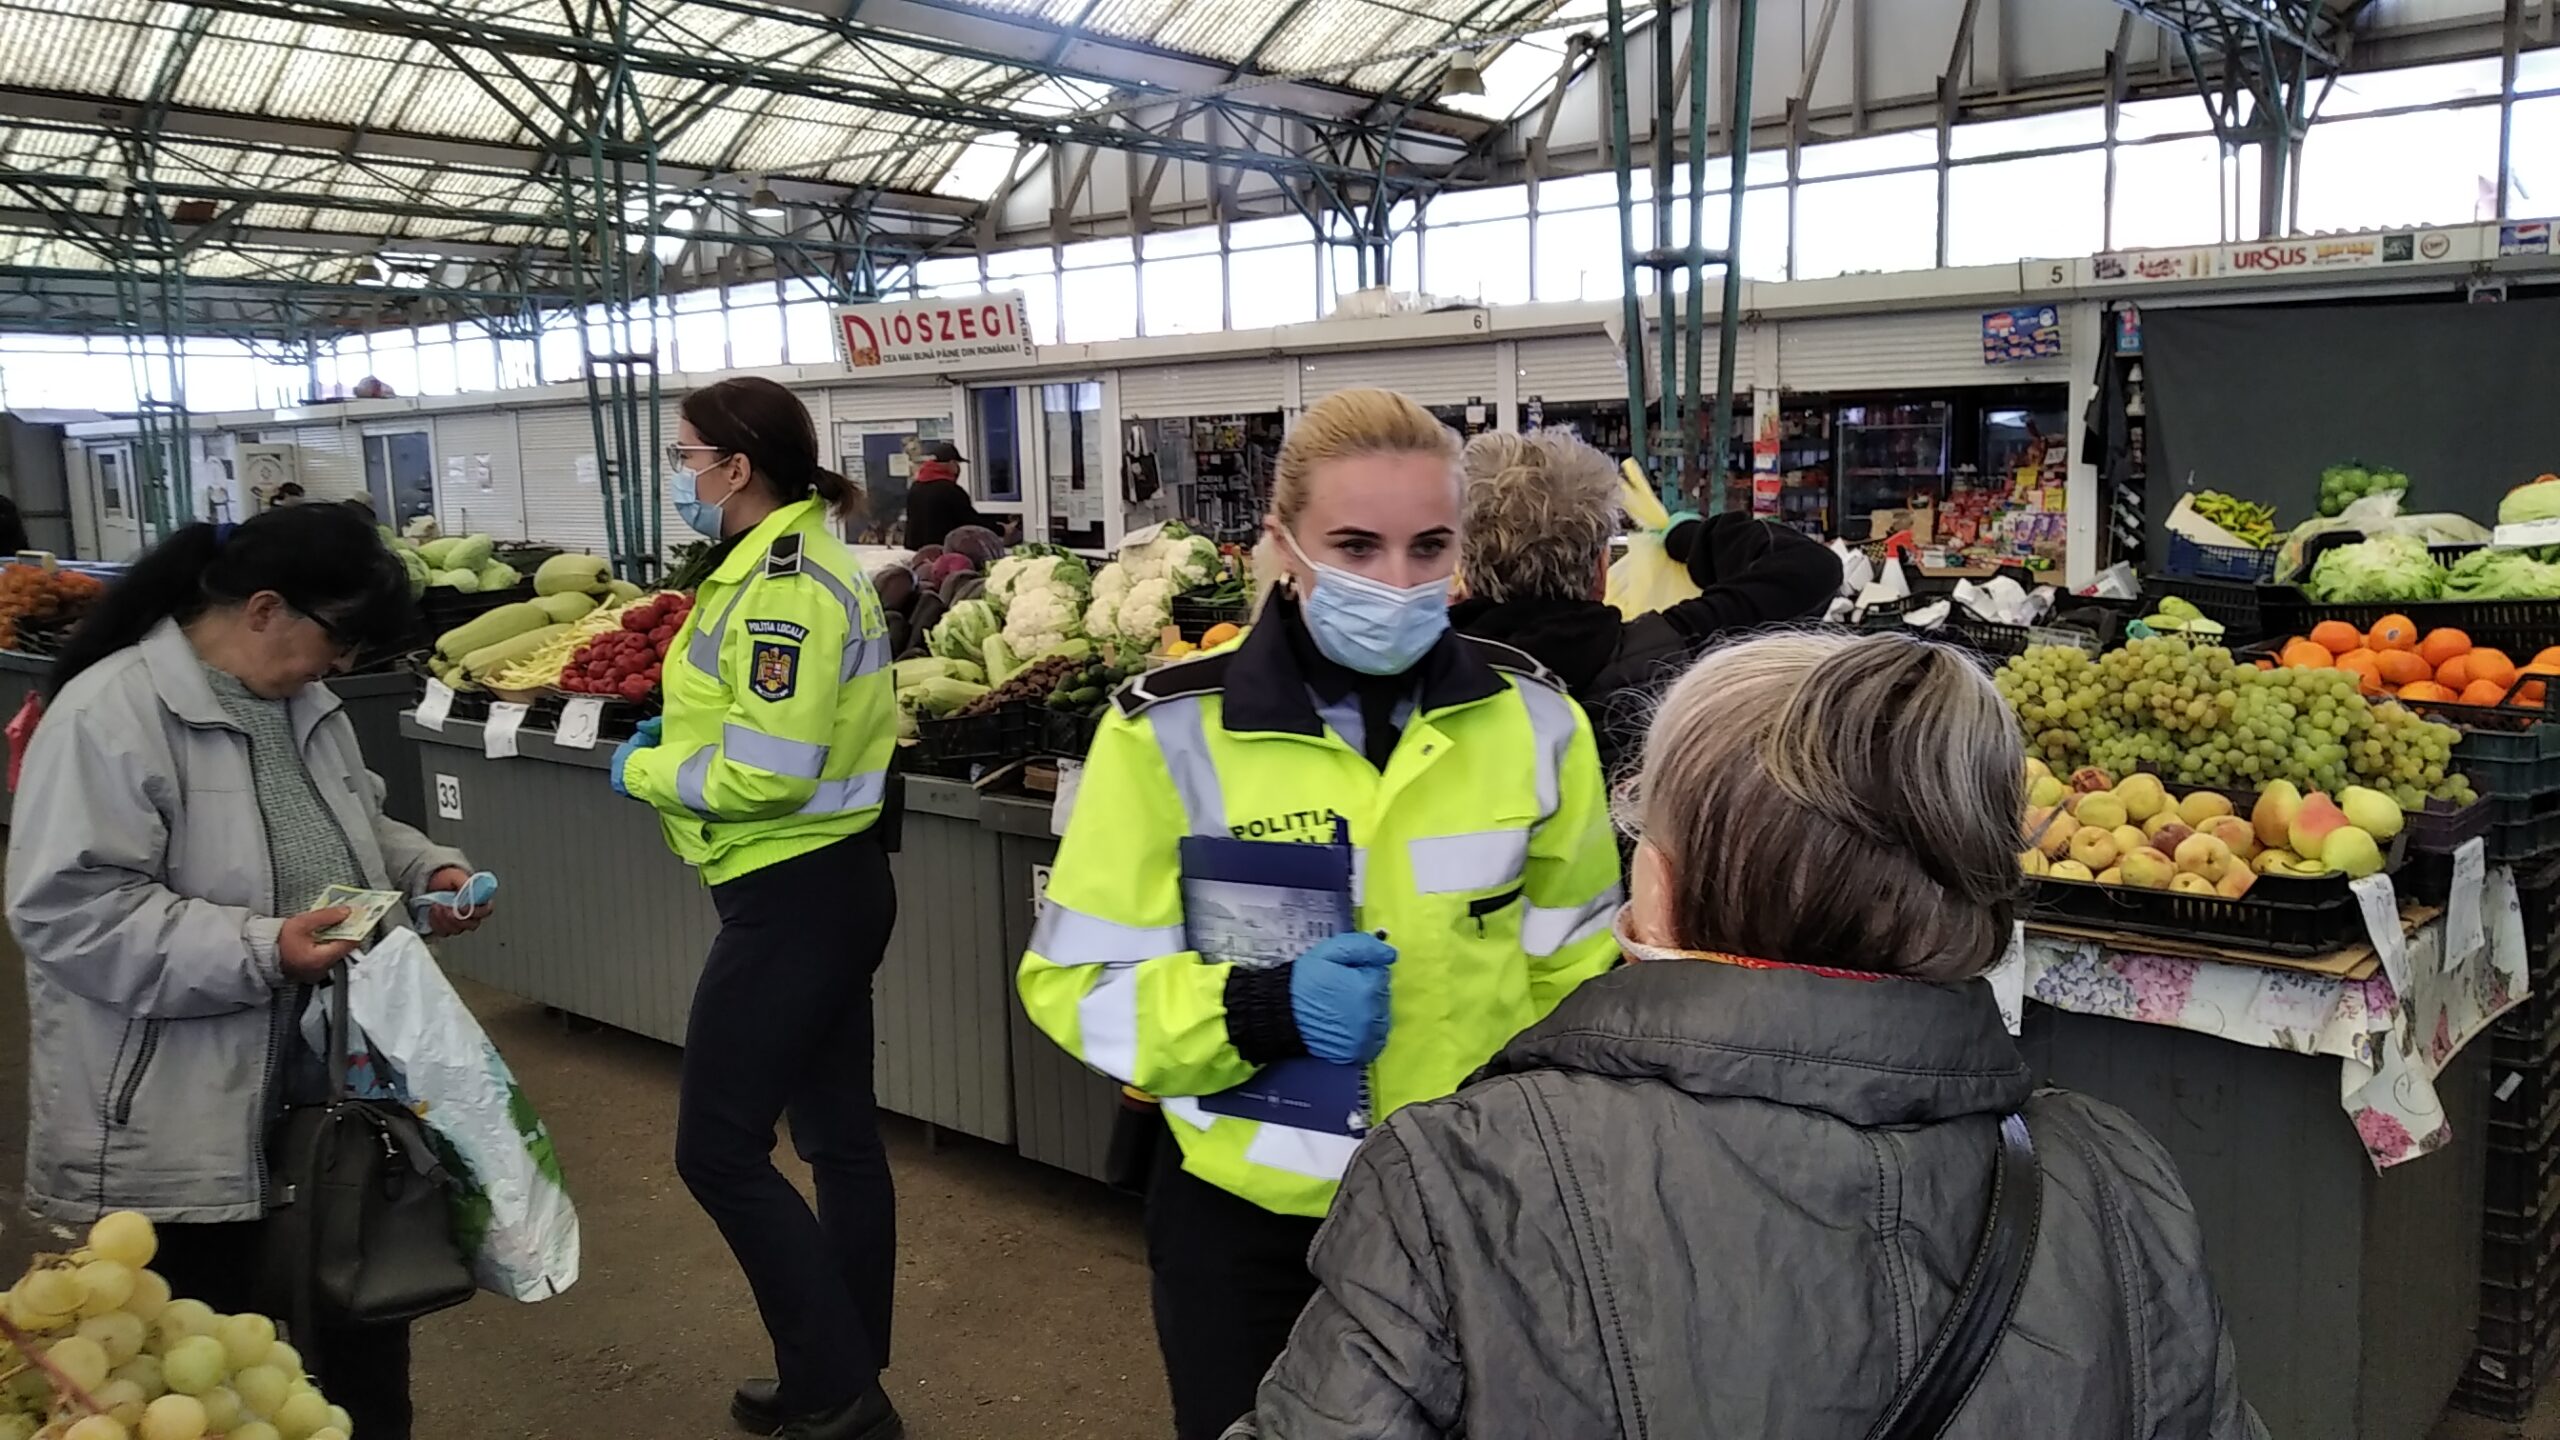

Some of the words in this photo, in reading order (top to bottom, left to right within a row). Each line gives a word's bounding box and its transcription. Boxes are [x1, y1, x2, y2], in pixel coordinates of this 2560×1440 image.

[2234, 245, 2307, 271] URSUS
[2051, 265, 2063, 284] 5
[1473, 313, 1483, 330] 6
[883, 354, 897, 363] CEA
[898, 353, 913, 361] MAI
[961, 346, 976, 354] DIN
[1082, 344, 1090, 358] 7
[440, 782, 458, 810] 33
